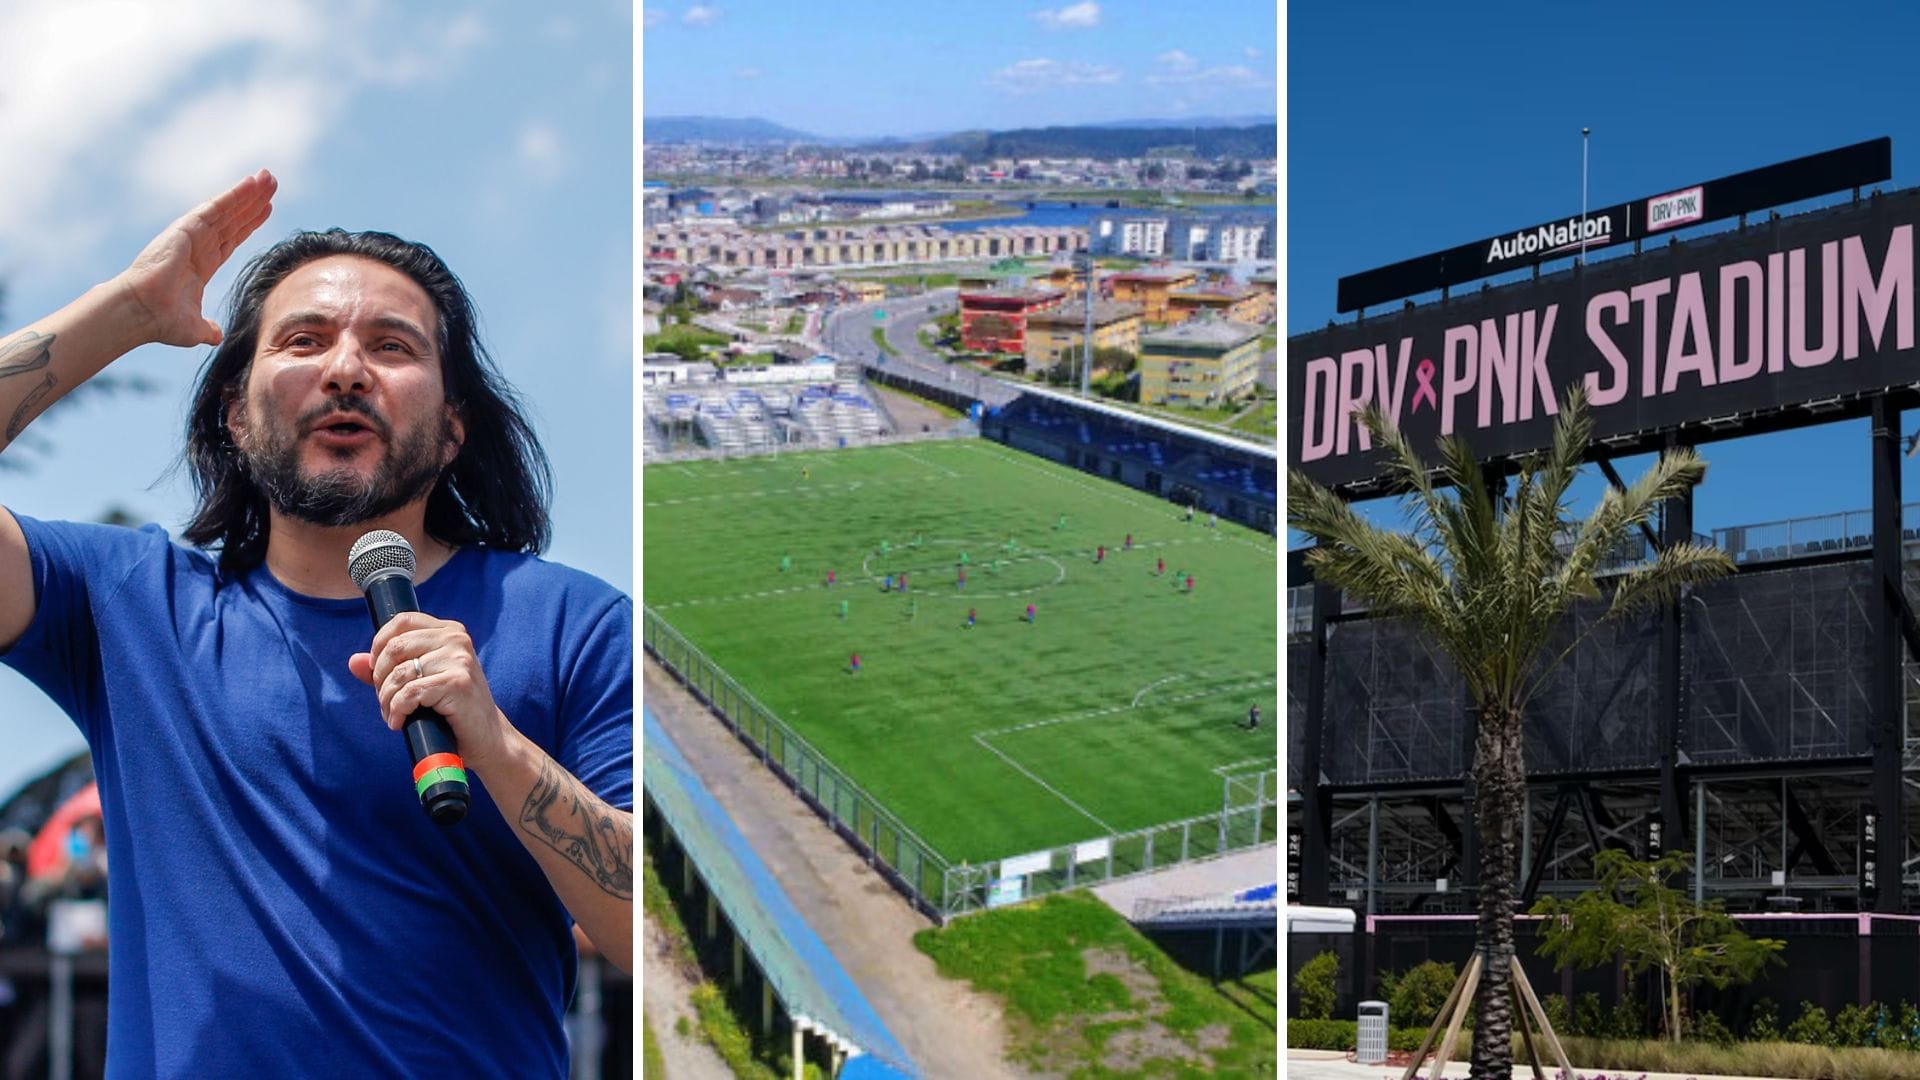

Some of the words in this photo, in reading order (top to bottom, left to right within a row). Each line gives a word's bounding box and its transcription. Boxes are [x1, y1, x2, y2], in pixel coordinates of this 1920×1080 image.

[1677, 195, 1697, 216] PNK
[1487, 215, 1611, 263] AutoNation
[1301, 337, 1413, 463] DRV
[1441, 303, 1559, 435] PNK
[1584, 224, 1914, 407] STADIUM
